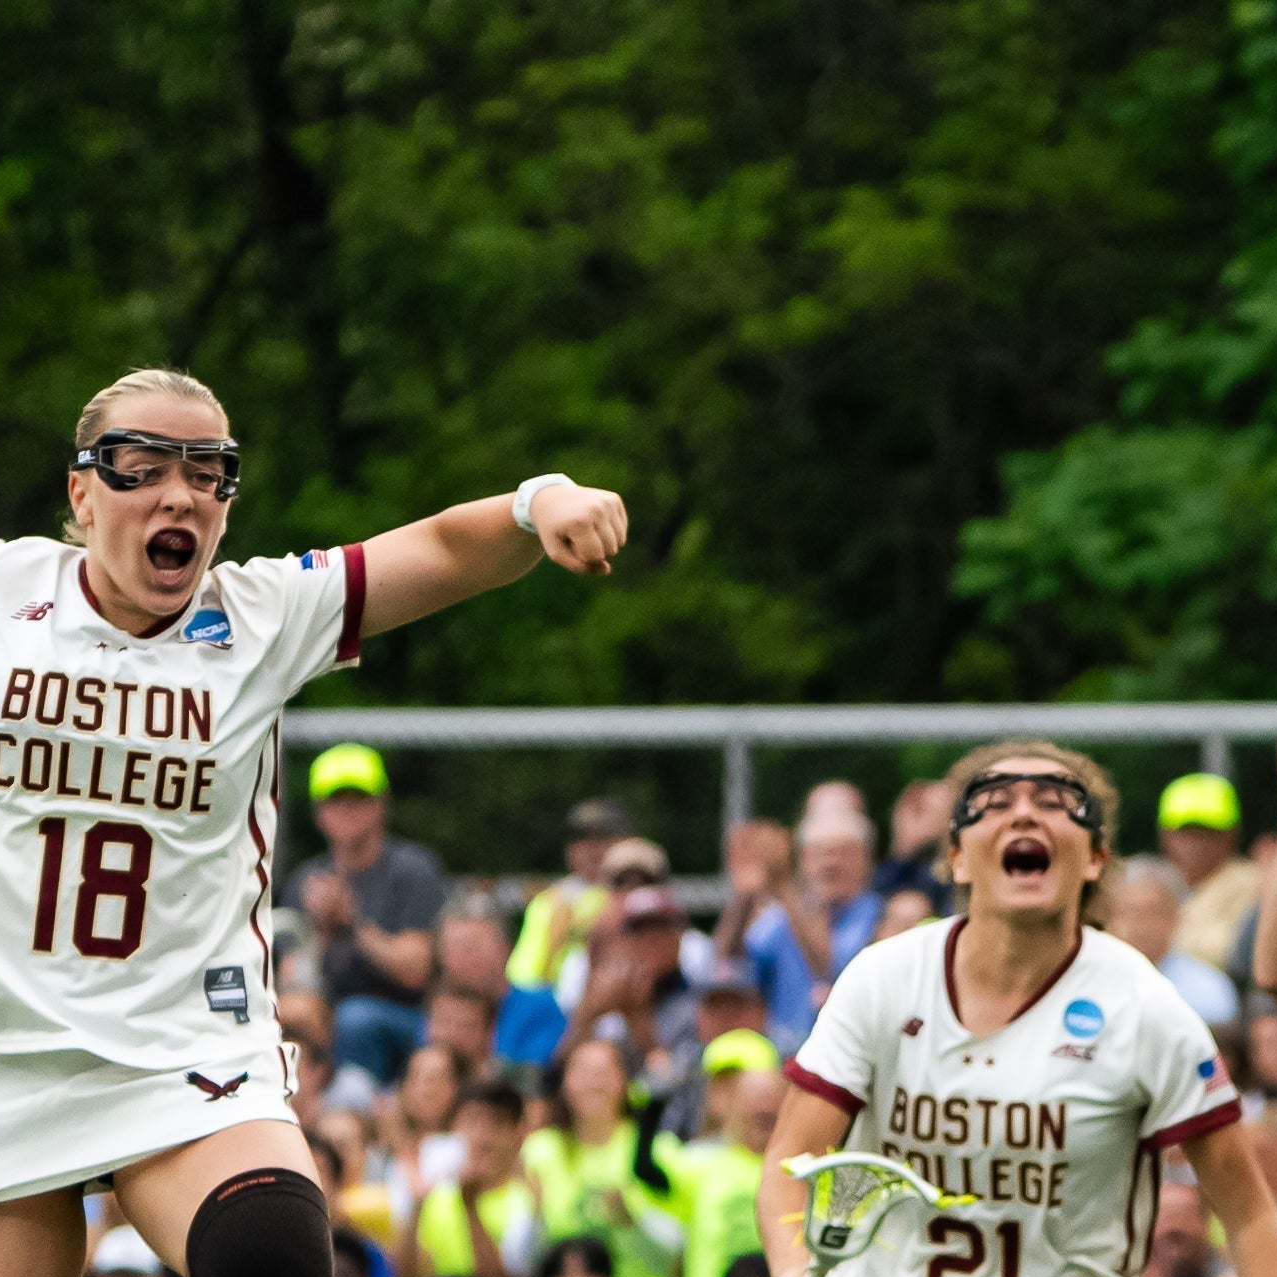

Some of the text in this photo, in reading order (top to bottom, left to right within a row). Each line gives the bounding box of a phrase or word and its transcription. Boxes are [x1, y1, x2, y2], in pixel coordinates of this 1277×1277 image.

[0, 667, 213, 744] BOSTON
[31, 816, 154, 961] 18
[889, 1086, 1067, 1151] BOSTON
